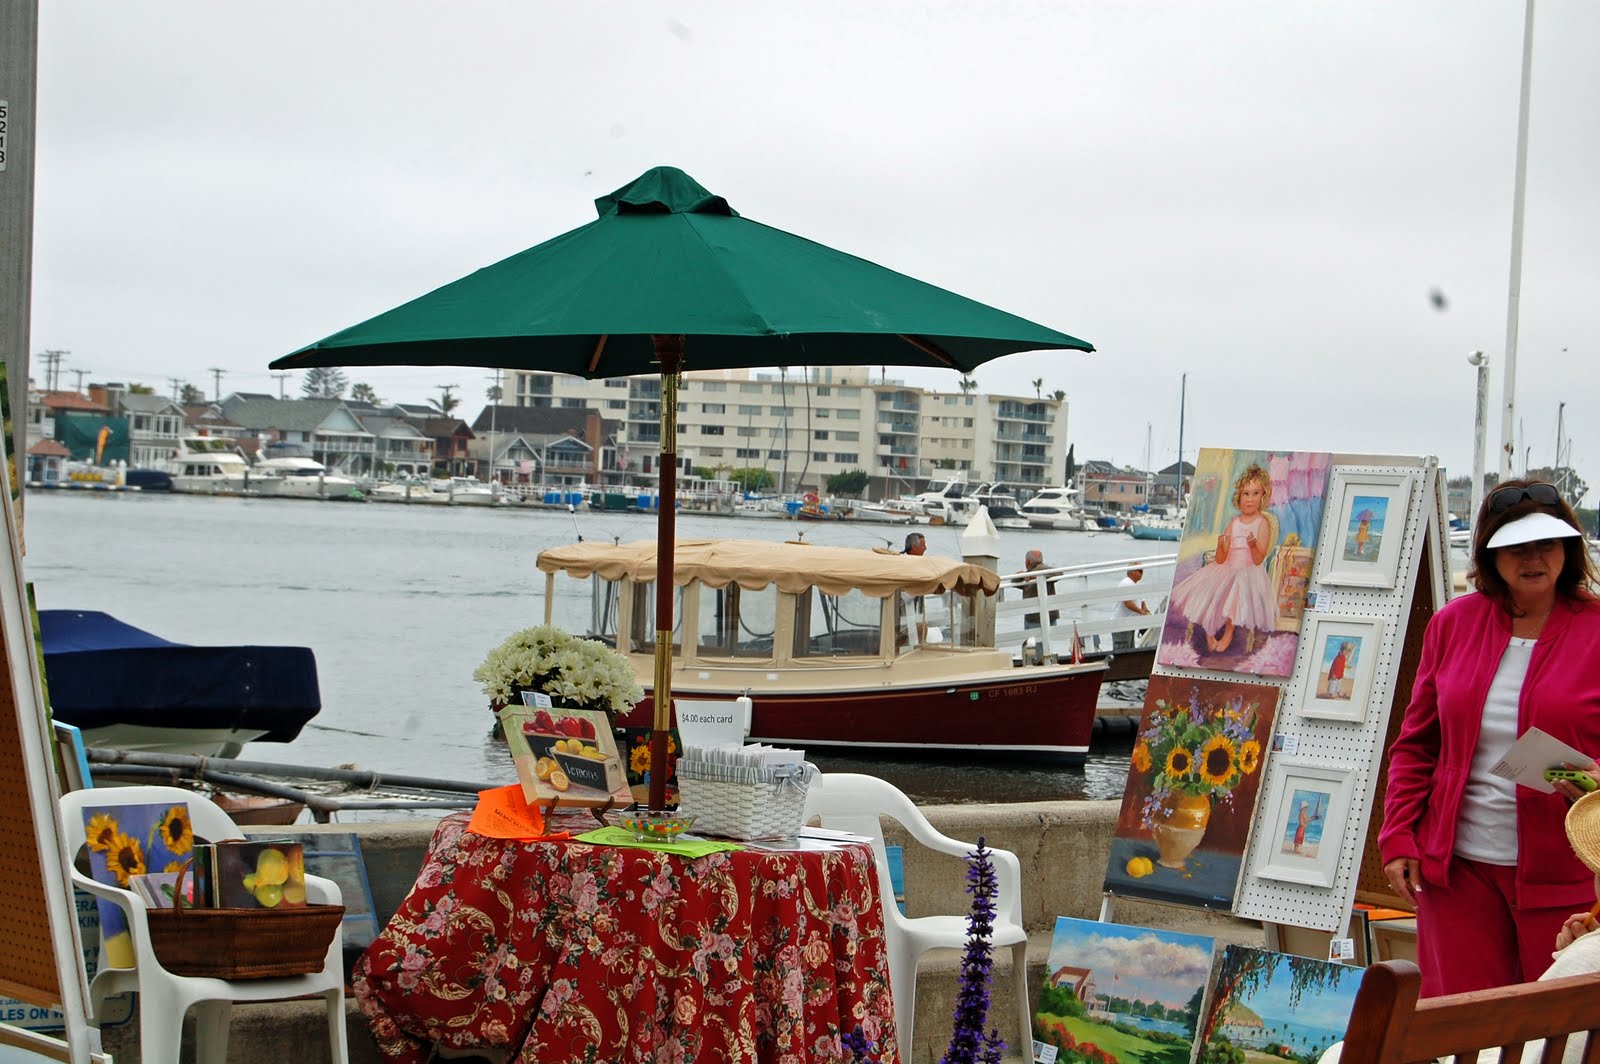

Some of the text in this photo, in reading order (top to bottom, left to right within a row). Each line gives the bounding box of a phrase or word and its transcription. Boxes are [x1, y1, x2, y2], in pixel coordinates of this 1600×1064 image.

[988, 689, 1000, 698] CF
[1025, 685, 1037, 694] RJ
[682, 712, 733, 723] $4.00 each card
[564, 761, 599, 781] lemons
[30, 1008, 49, 1020] ON
